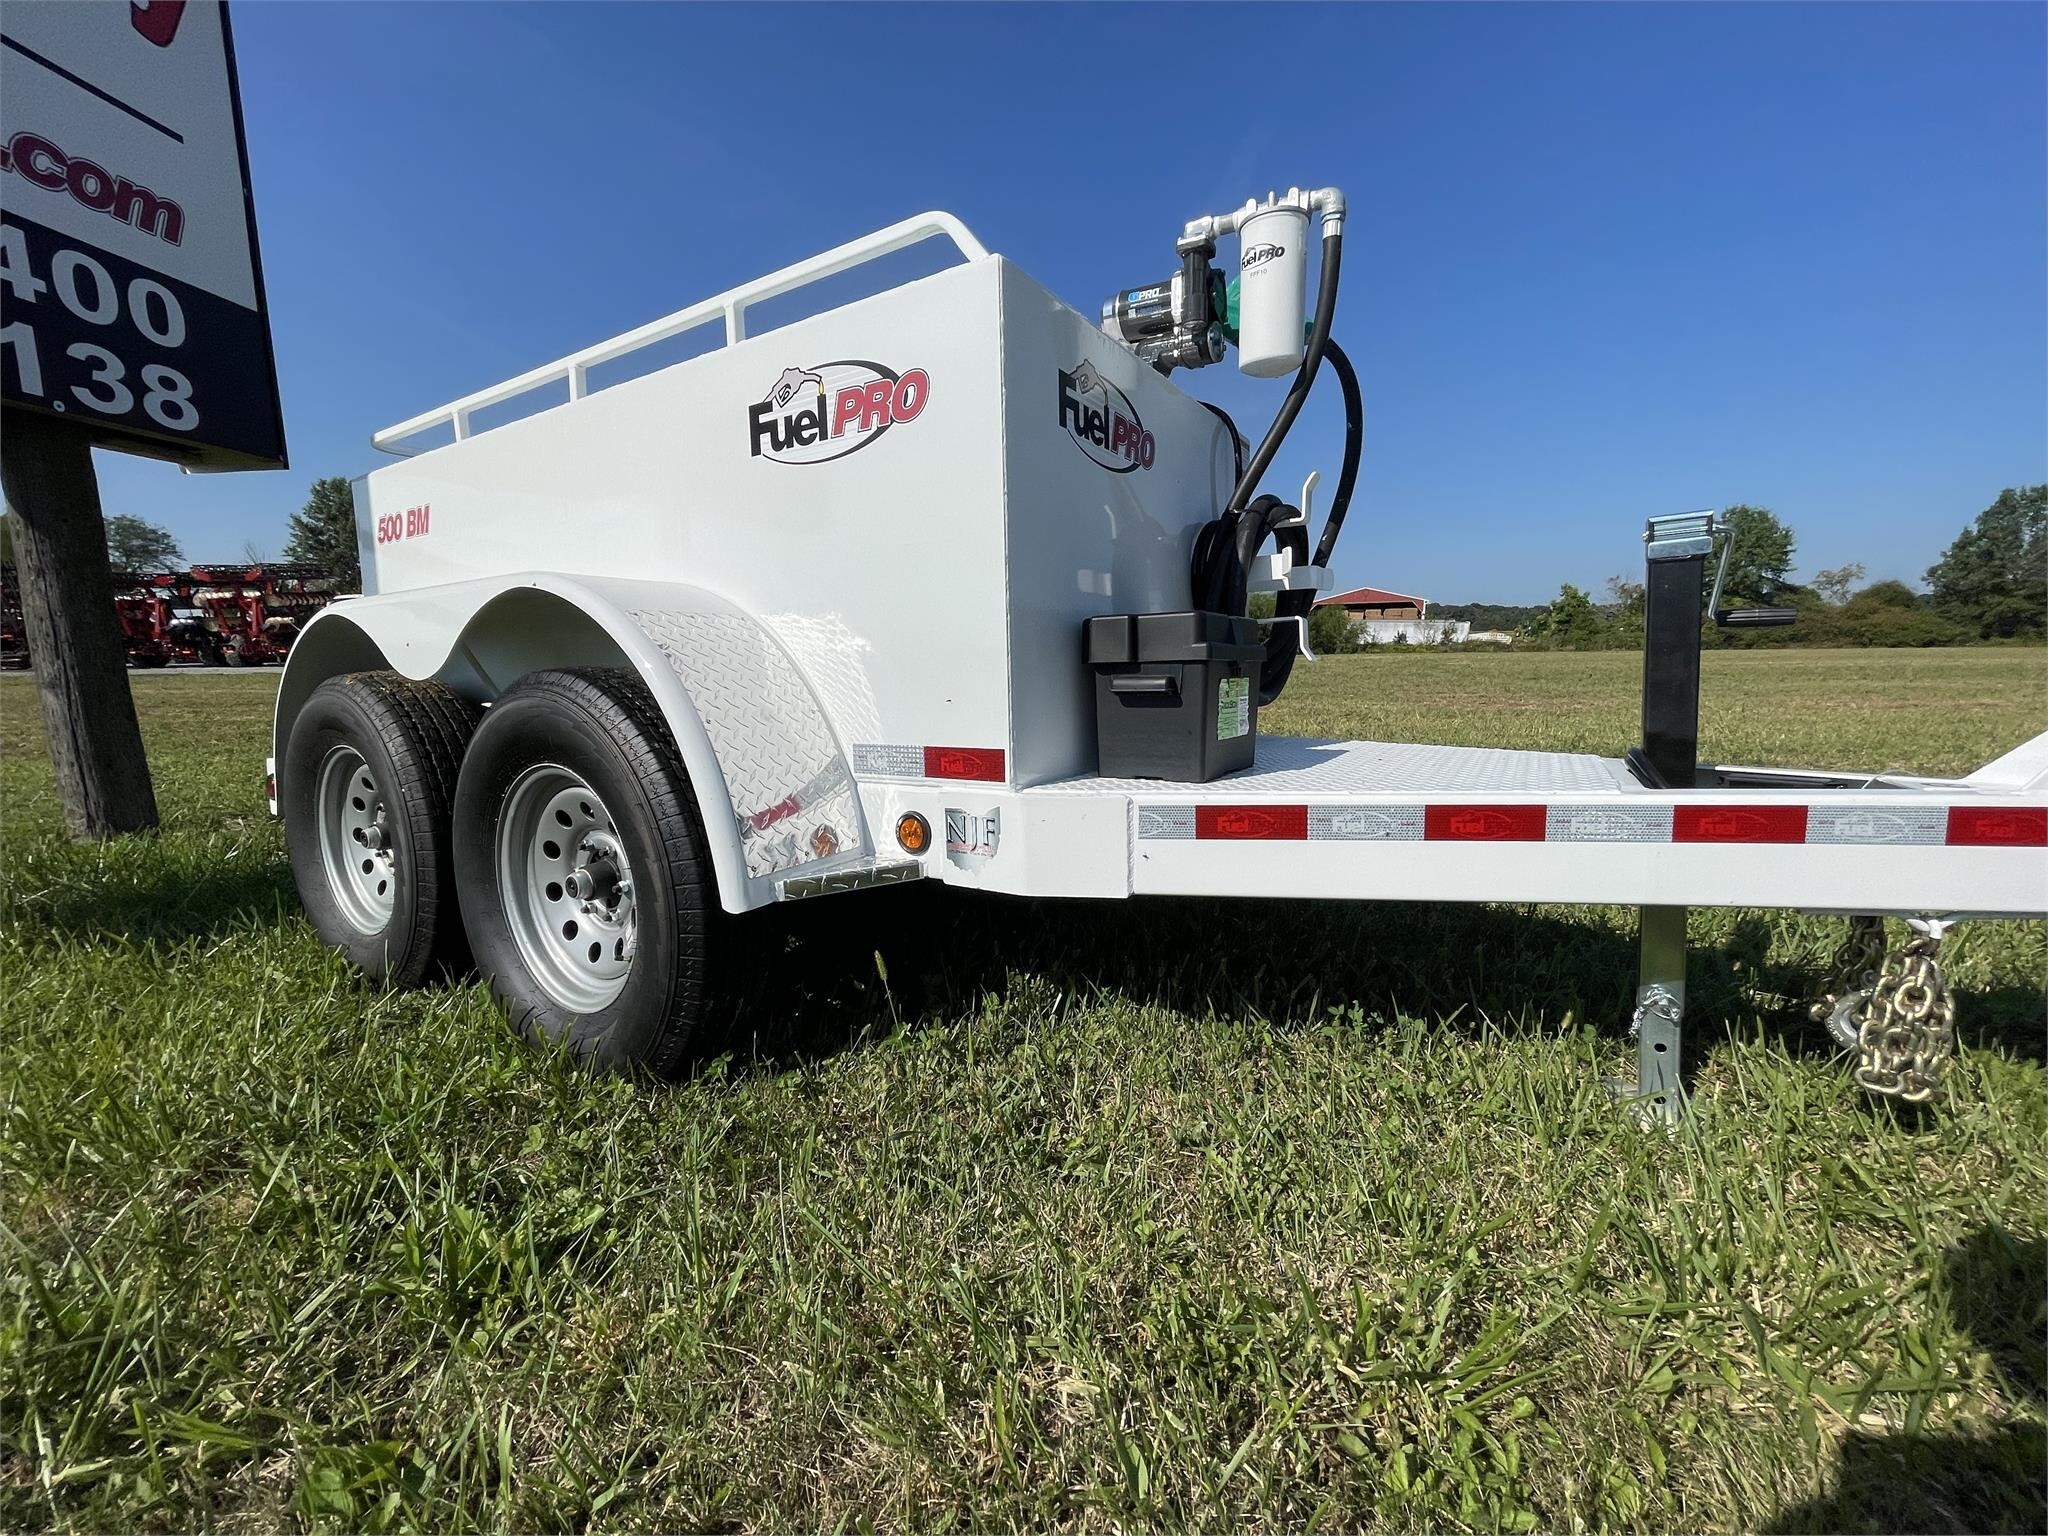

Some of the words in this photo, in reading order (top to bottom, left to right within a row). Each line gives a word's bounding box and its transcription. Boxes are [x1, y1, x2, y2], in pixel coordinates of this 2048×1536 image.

[378, 514, 403, 544] 500
[405, 504, 430, 539] BM
[946, 814, 996, 852] NJF
